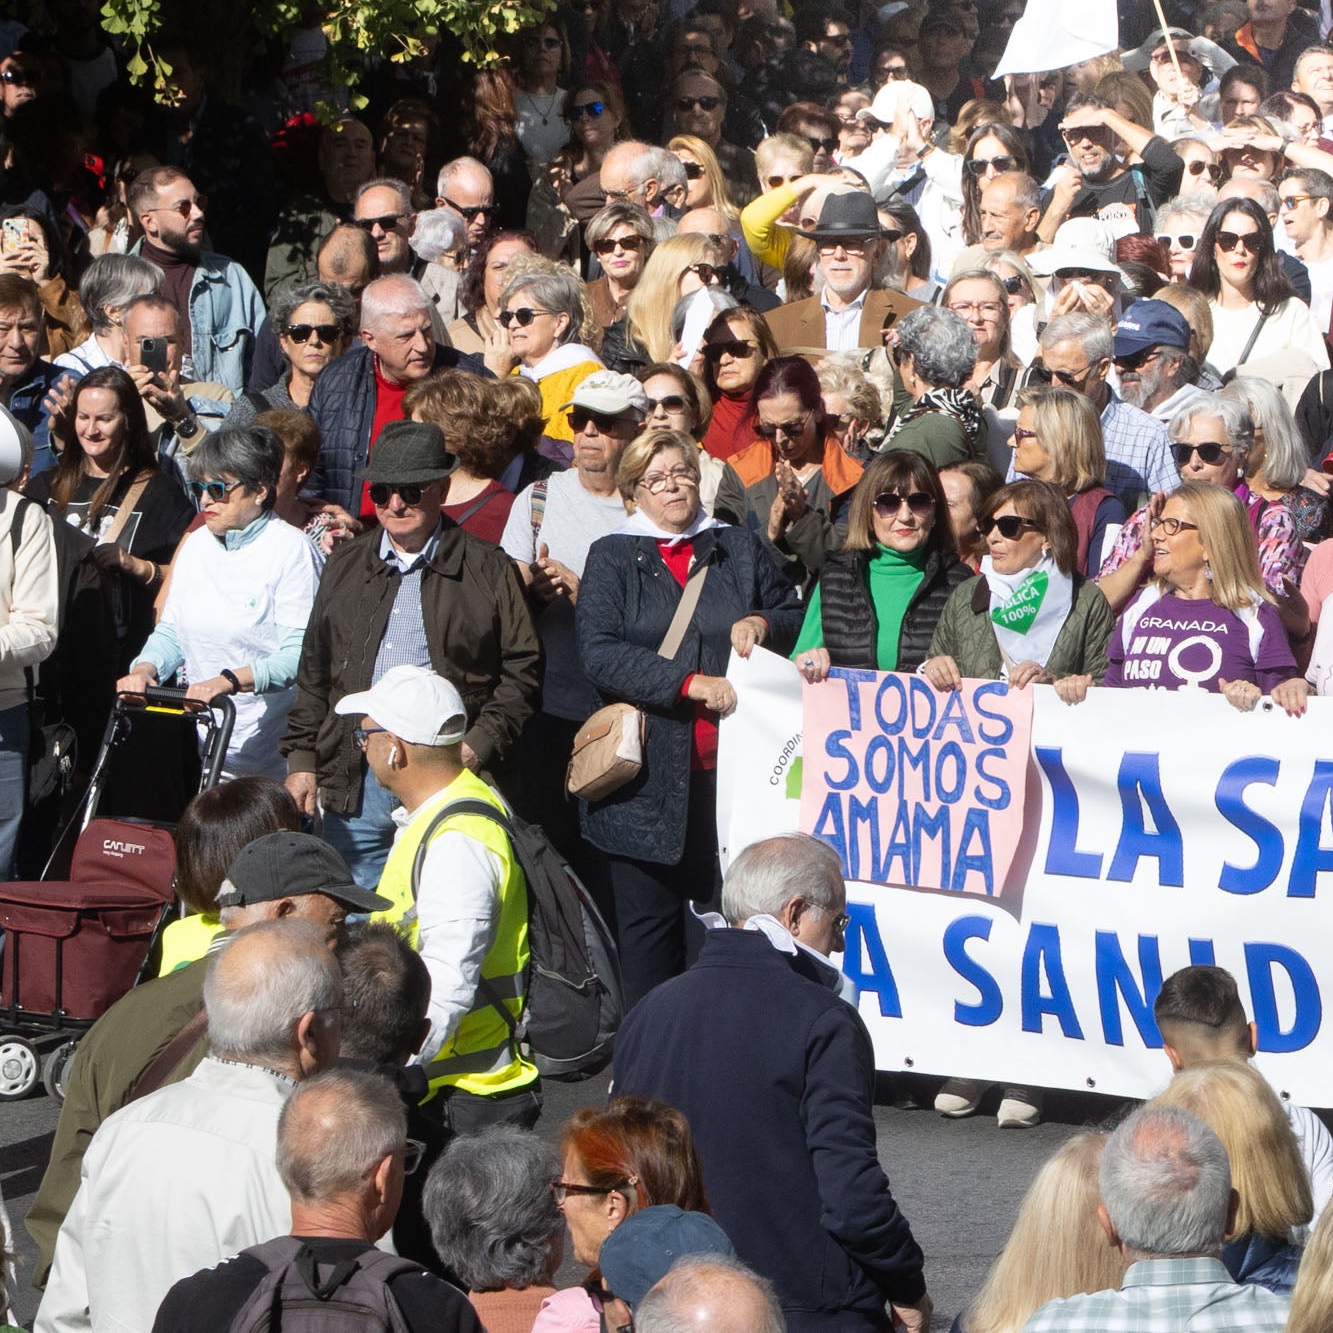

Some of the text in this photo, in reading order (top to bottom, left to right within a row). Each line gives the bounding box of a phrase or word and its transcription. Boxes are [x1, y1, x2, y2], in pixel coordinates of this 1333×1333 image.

[1001, 603, 1037, 624] 100%
[1140, 617, 1229, 635] GRANADA
[1124, 659, 1163, 681] PASO
[1145, 636, 1172, 655] UN
[826, 665, 1014, 747] TODAS
[823, 729, 1012, 811] SOMOS
[1035, 745, 1185, 888] LA
[812, 791, 994, 897] AMAMA
